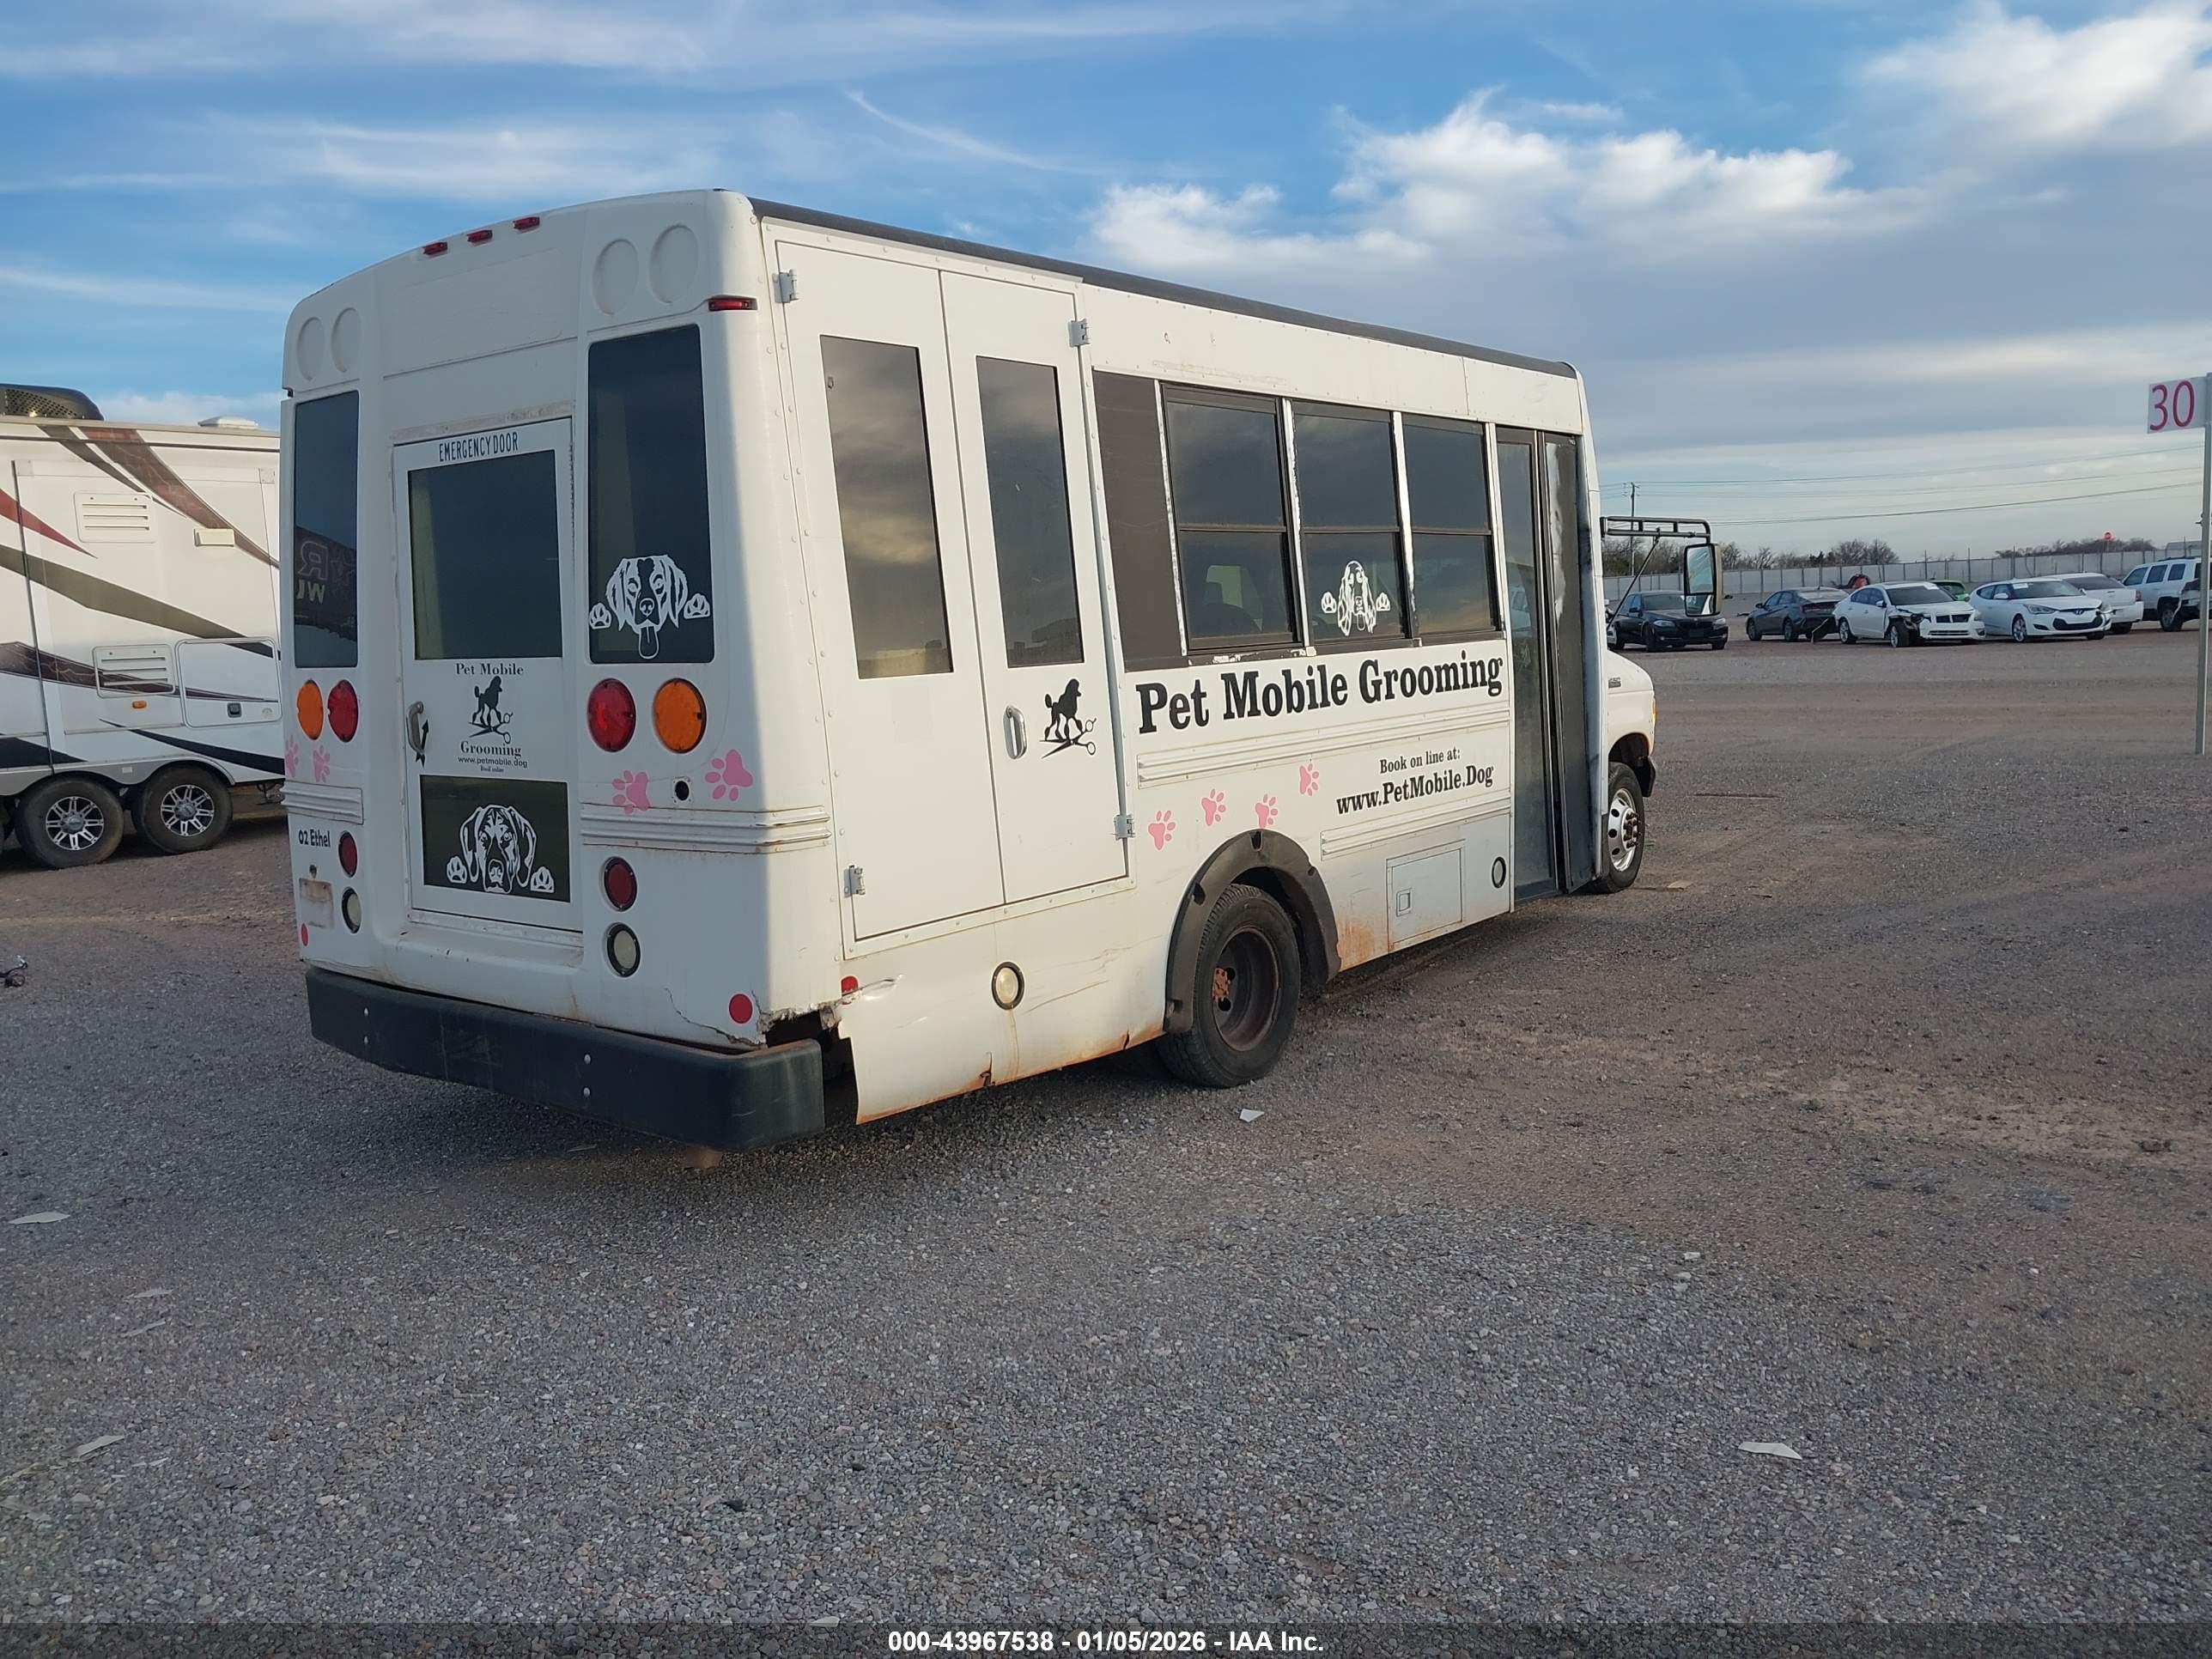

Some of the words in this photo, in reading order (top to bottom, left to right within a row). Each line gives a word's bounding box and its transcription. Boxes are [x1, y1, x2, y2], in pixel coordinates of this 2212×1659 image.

[2150, 380, 2195, 430] 30
[439, 434, 491, 462] EMERGENCY
[493, 432, 518, 453] DOOR
[455, 663, 475, 675] Pet
[480, 663, 524, 675] Mobile
[1135, 679, 1209, 734] Pet
[1220, 664, 1348, 720] Mobile
[1358, 650, 1504, 703] Grooming
[458, 757, 528, 769] www.petmobile.dog
[460, 740, 522, 758] Grooming
[1379, 756, 1407, 774] Book
[1410, 756, 1423, 768] on
[1425, 749, 1444, 765] line
[1447, 745, 1461, 760] at:
[1336, 764, 1494, 815] www.PetMobile.Dog
[310, 829, 331, 848] Ethel
